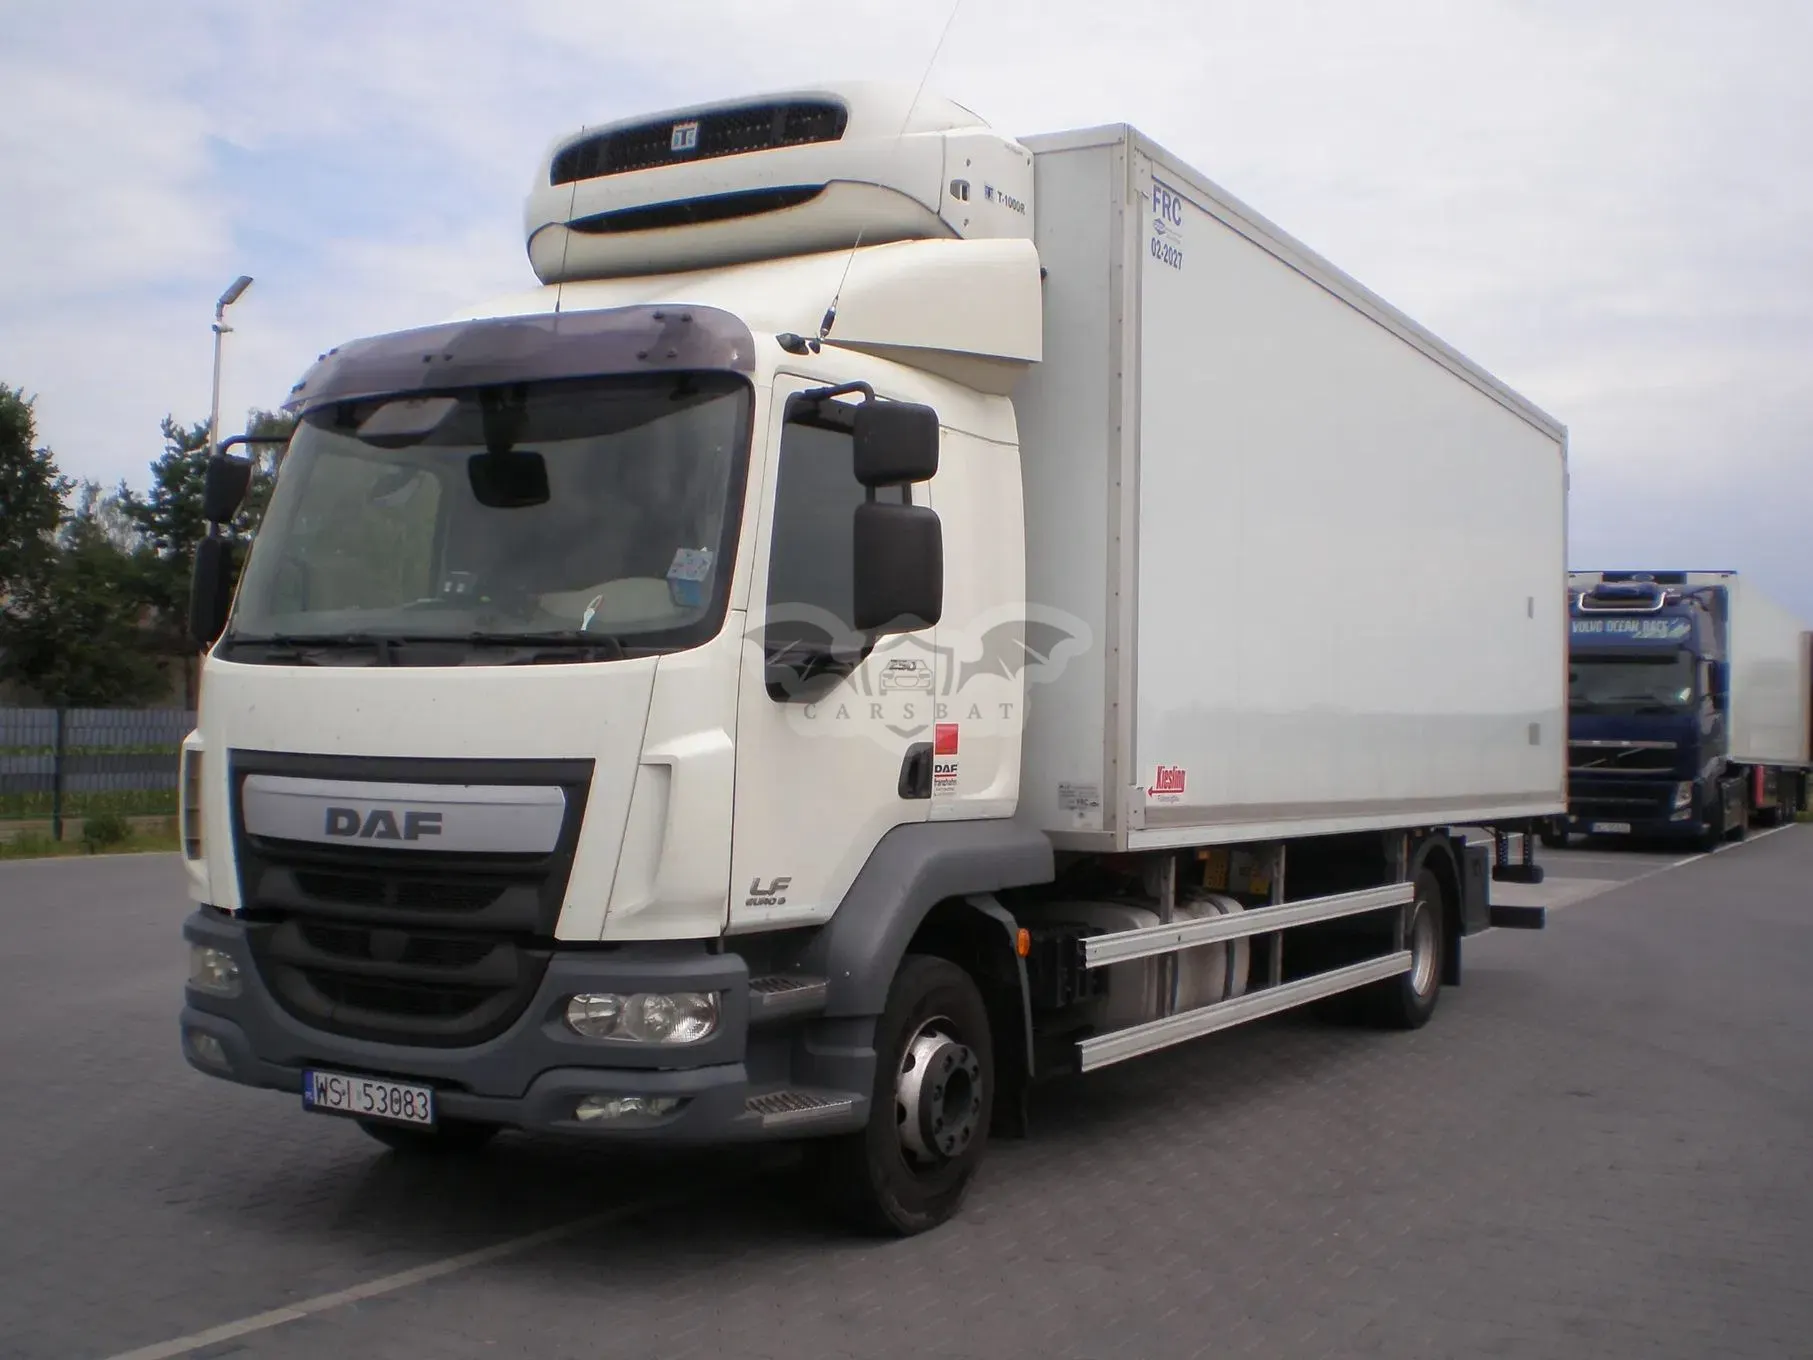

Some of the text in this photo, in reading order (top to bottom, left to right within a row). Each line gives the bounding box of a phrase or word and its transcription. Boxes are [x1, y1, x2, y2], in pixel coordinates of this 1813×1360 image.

[997, 190, 1025, 215] T-1000R
[1153, 184, 1181, 226] FRC
[1151, 237, 1182, 270] 02-2027
[1572, 620, 1603, 633] VOLVO
[1606, 620, 1639, 633] OCEAN
[934, 764, 958, 773] DAF
[324, 807, 442, 840] DAF
[750, 877, 792, 895] LF
[315, 1075, 428, 1121] WSI 53083
